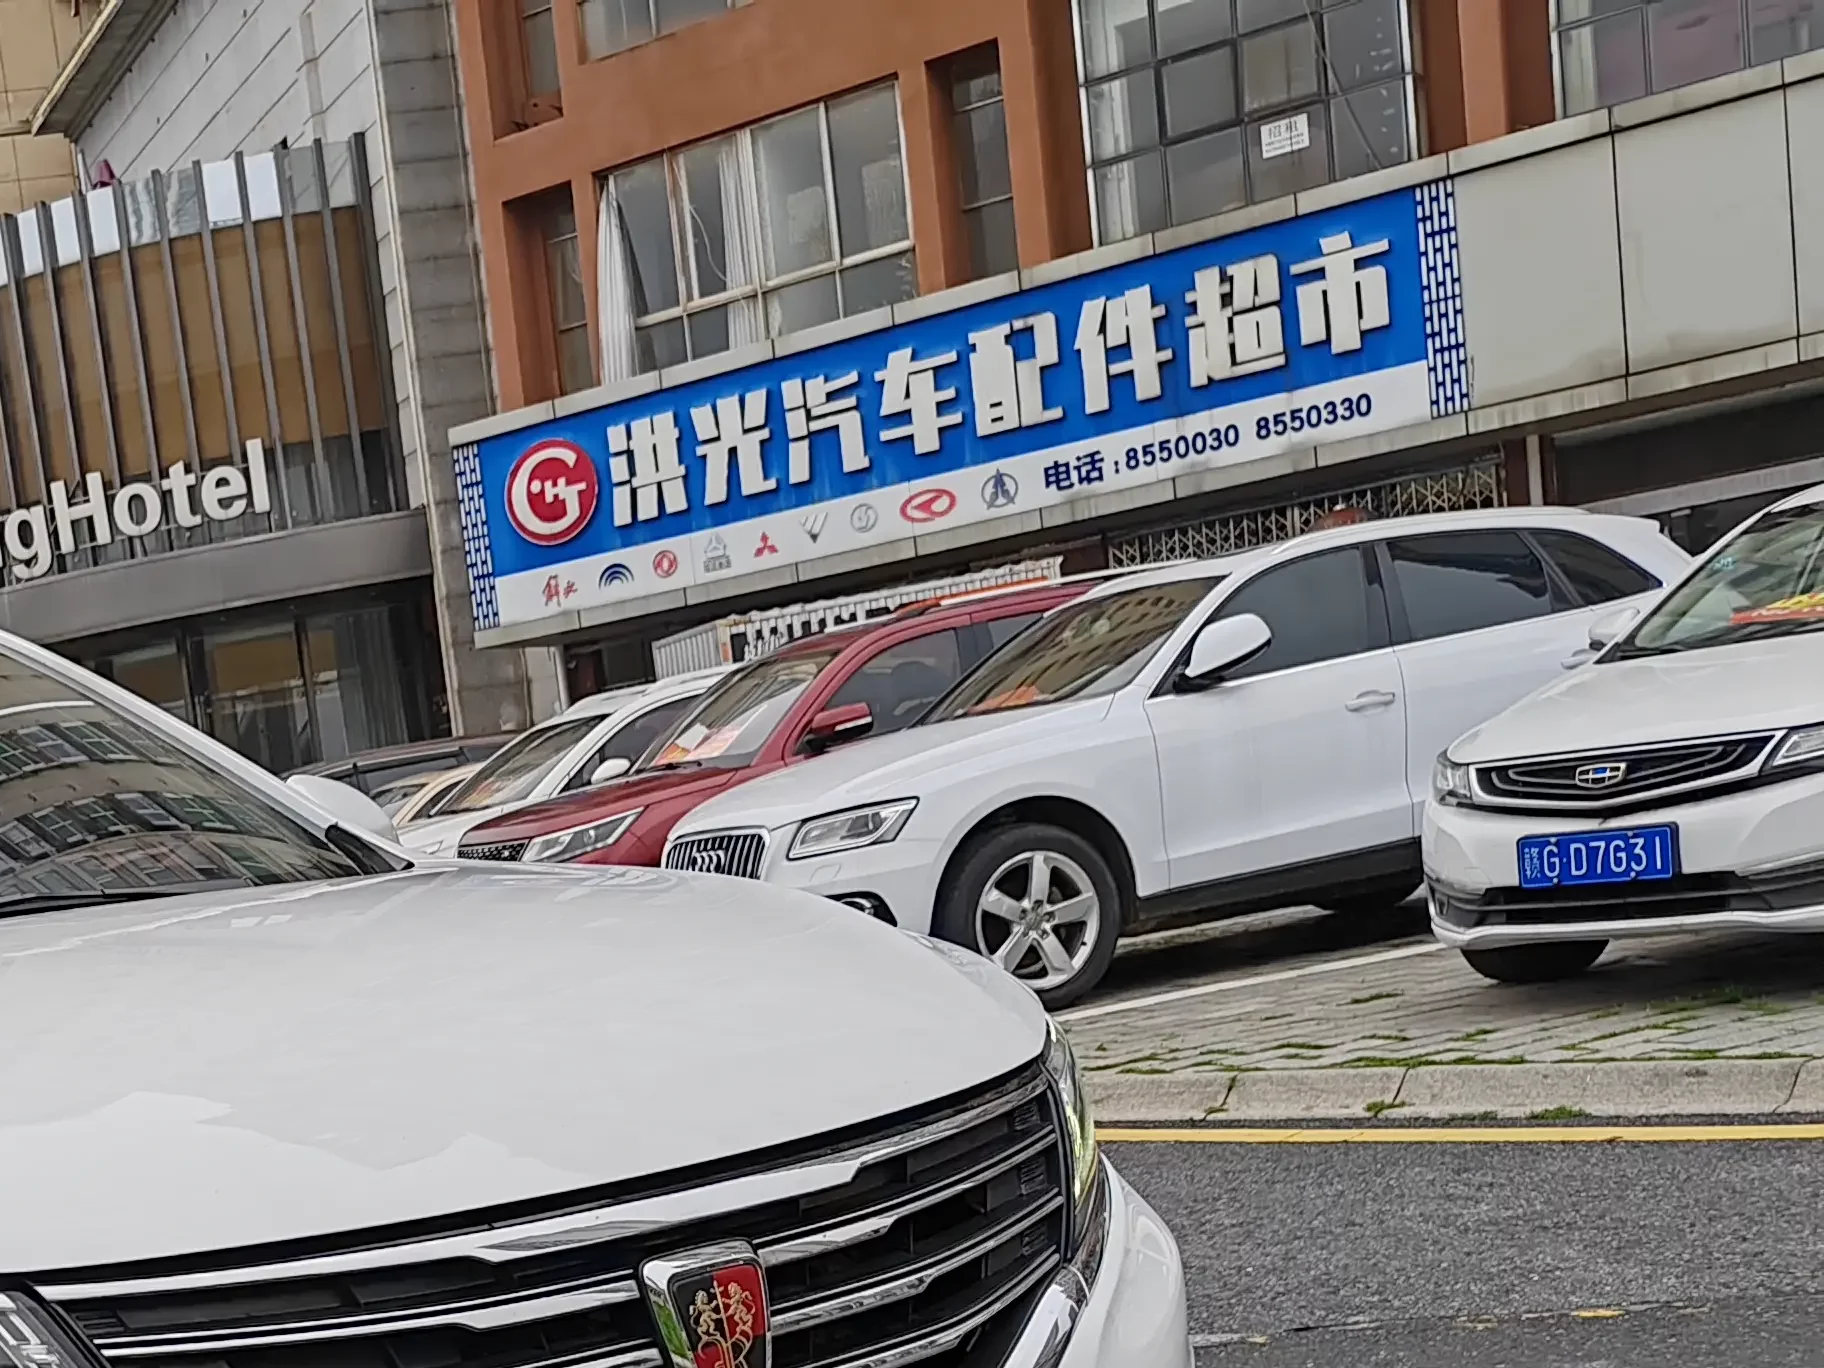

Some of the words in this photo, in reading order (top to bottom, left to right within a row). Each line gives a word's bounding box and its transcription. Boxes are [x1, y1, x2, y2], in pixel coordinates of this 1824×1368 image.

[607, 231, 1390, 527] 洪光汽车配件超市
[1255, 392, 1373, 439] 8550330
